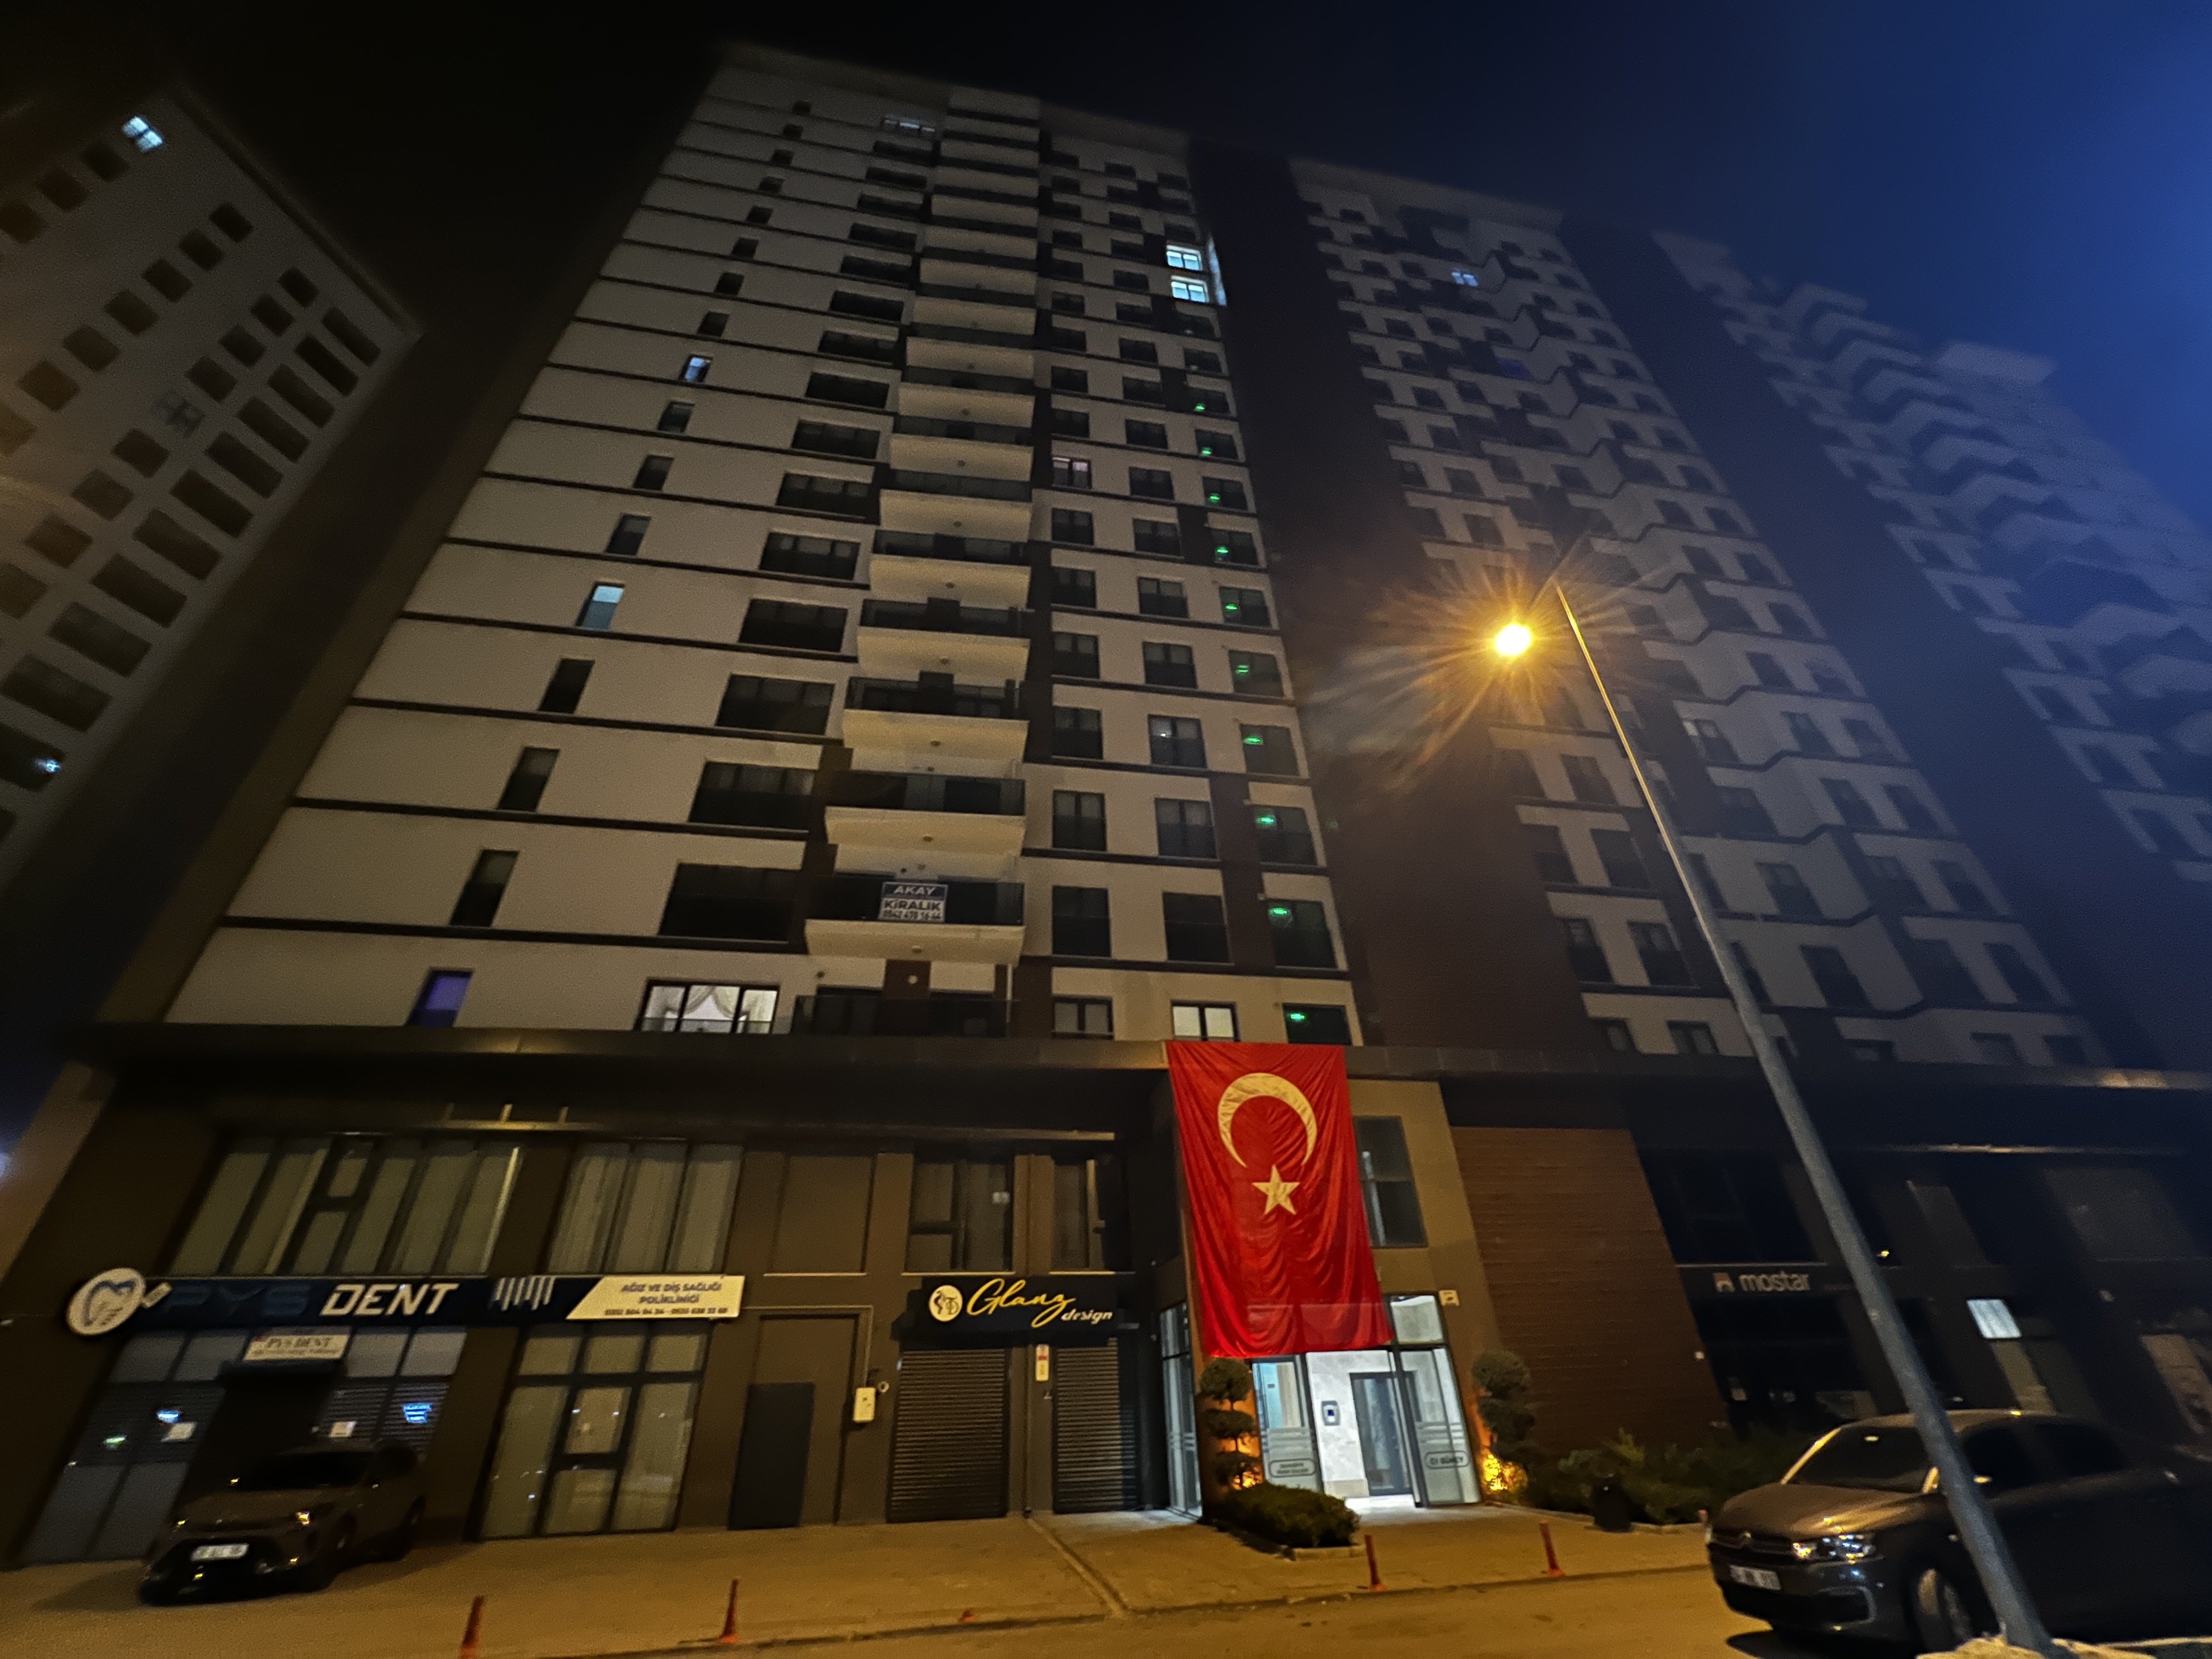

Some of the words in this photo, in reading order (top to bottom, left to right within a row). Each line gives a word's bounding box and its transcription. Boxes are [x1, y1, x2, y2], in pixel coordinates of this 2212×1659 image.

[893, 885, 936, 895] AKAY
[885, 899, 940, 911] KİRALIK
[622, 1283, 646, 1292] AĞIZ
[648, 1283, 663, 1292] VE
[663, 1282, 681, 1293] DİŞ
[683, 1282, 721, 1291] SAĞLIĞI
[1739, 1270, 1811, 1292] mostar
[319, 1283, 461, 1317] DENT
[966, 1278, 1076, 1328] Glanz
[1061, 1308, 1113, 1325] design
